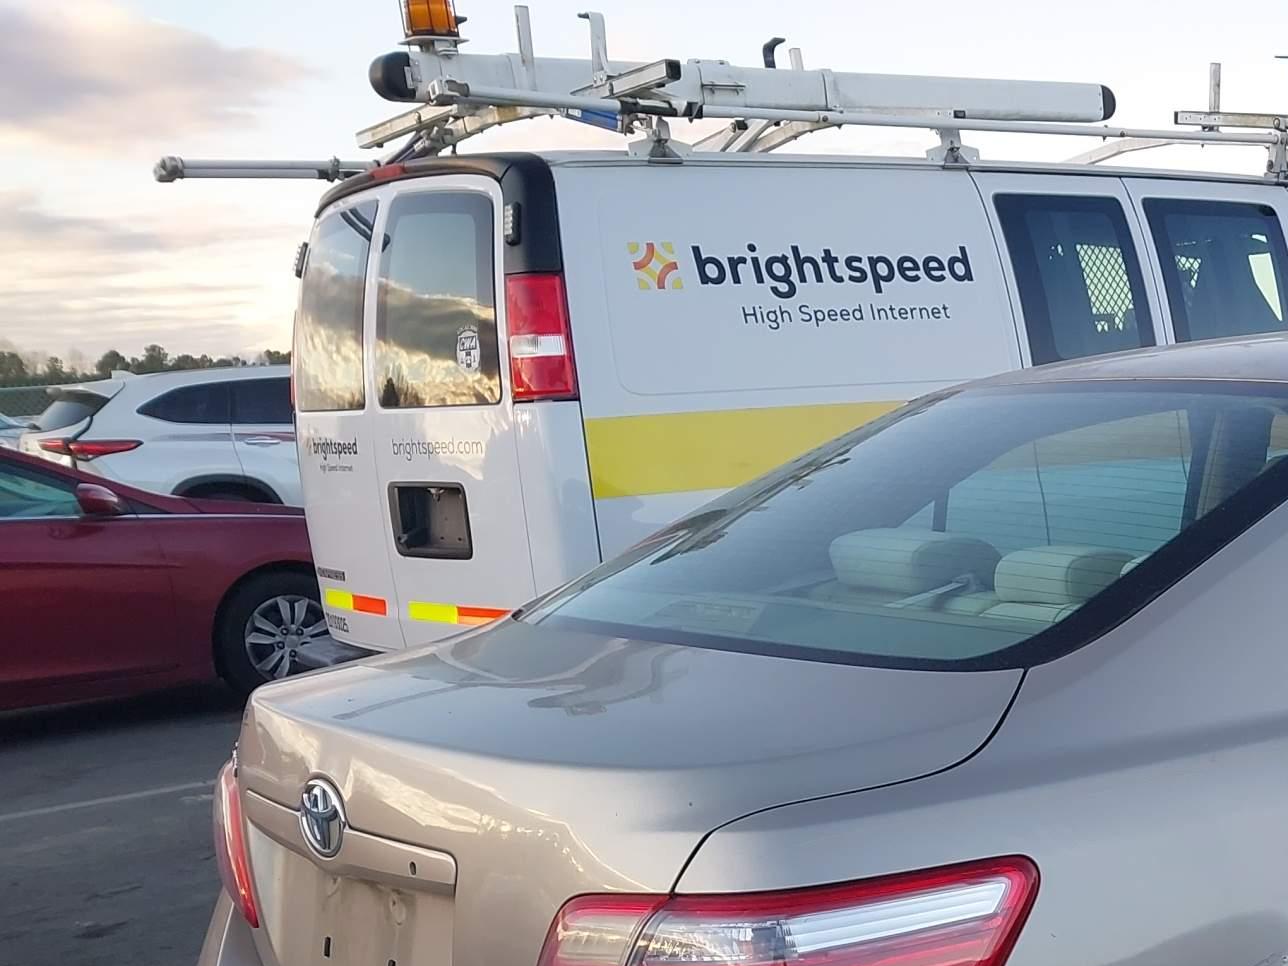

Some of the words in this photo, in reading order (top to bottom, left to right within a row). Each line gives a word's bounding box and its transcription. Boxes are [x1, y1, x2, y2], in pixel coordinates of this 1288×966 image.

[690, 243, 975, 299] brightspeed
[741, 304, 793, 331] High
[798, 303, 865, 328] Speed
[870, 302, 951, 321] Internet
[312, 436, 358, 461] brightspeed
[391, 437, 484, 462] brightspeed.com
